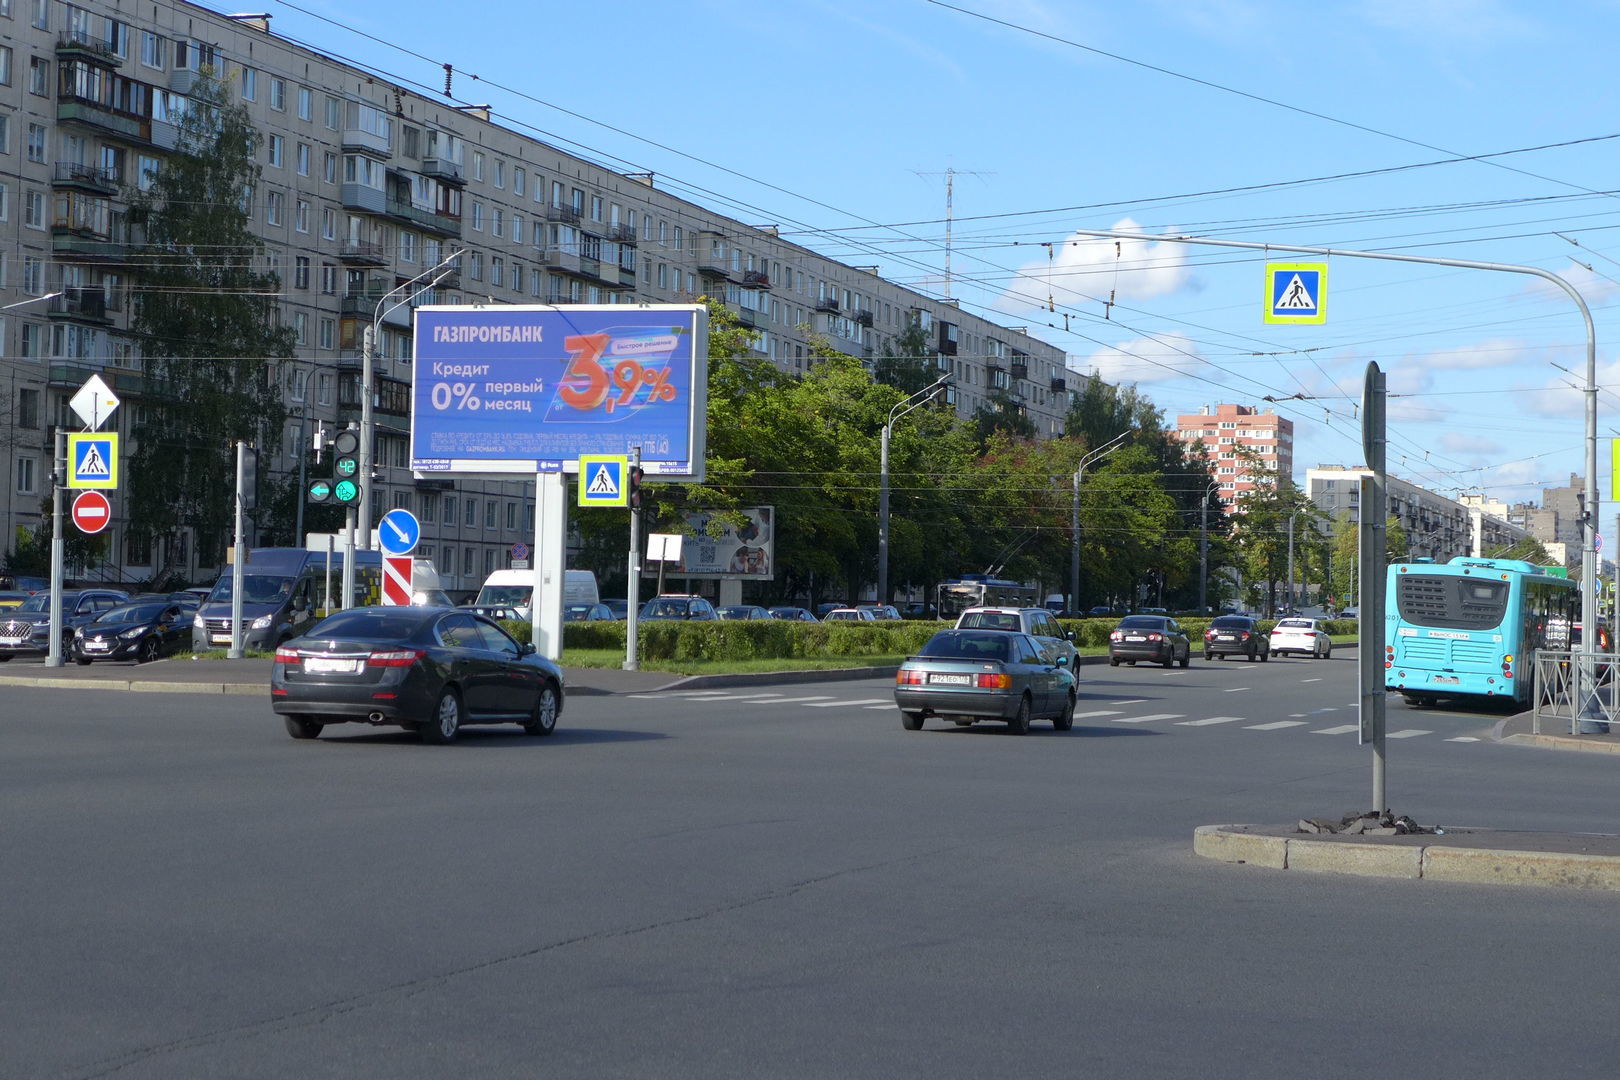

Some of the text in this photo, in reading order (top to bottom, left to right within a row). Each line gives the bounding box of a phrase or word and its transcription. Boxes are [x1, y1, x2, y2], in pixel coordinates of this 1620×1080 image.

[433, 325, 543, 343] ГАЗПРОМБАНК
[432, 362, 490, 378] Кредит
[559, 332, 678, 414] 3,9%
[485, 378, 543, 396] первый
[431, 382, 481, 411] 0%
[484, 400, 532, 413] месяц
[339, 460, 355, 473] 42
